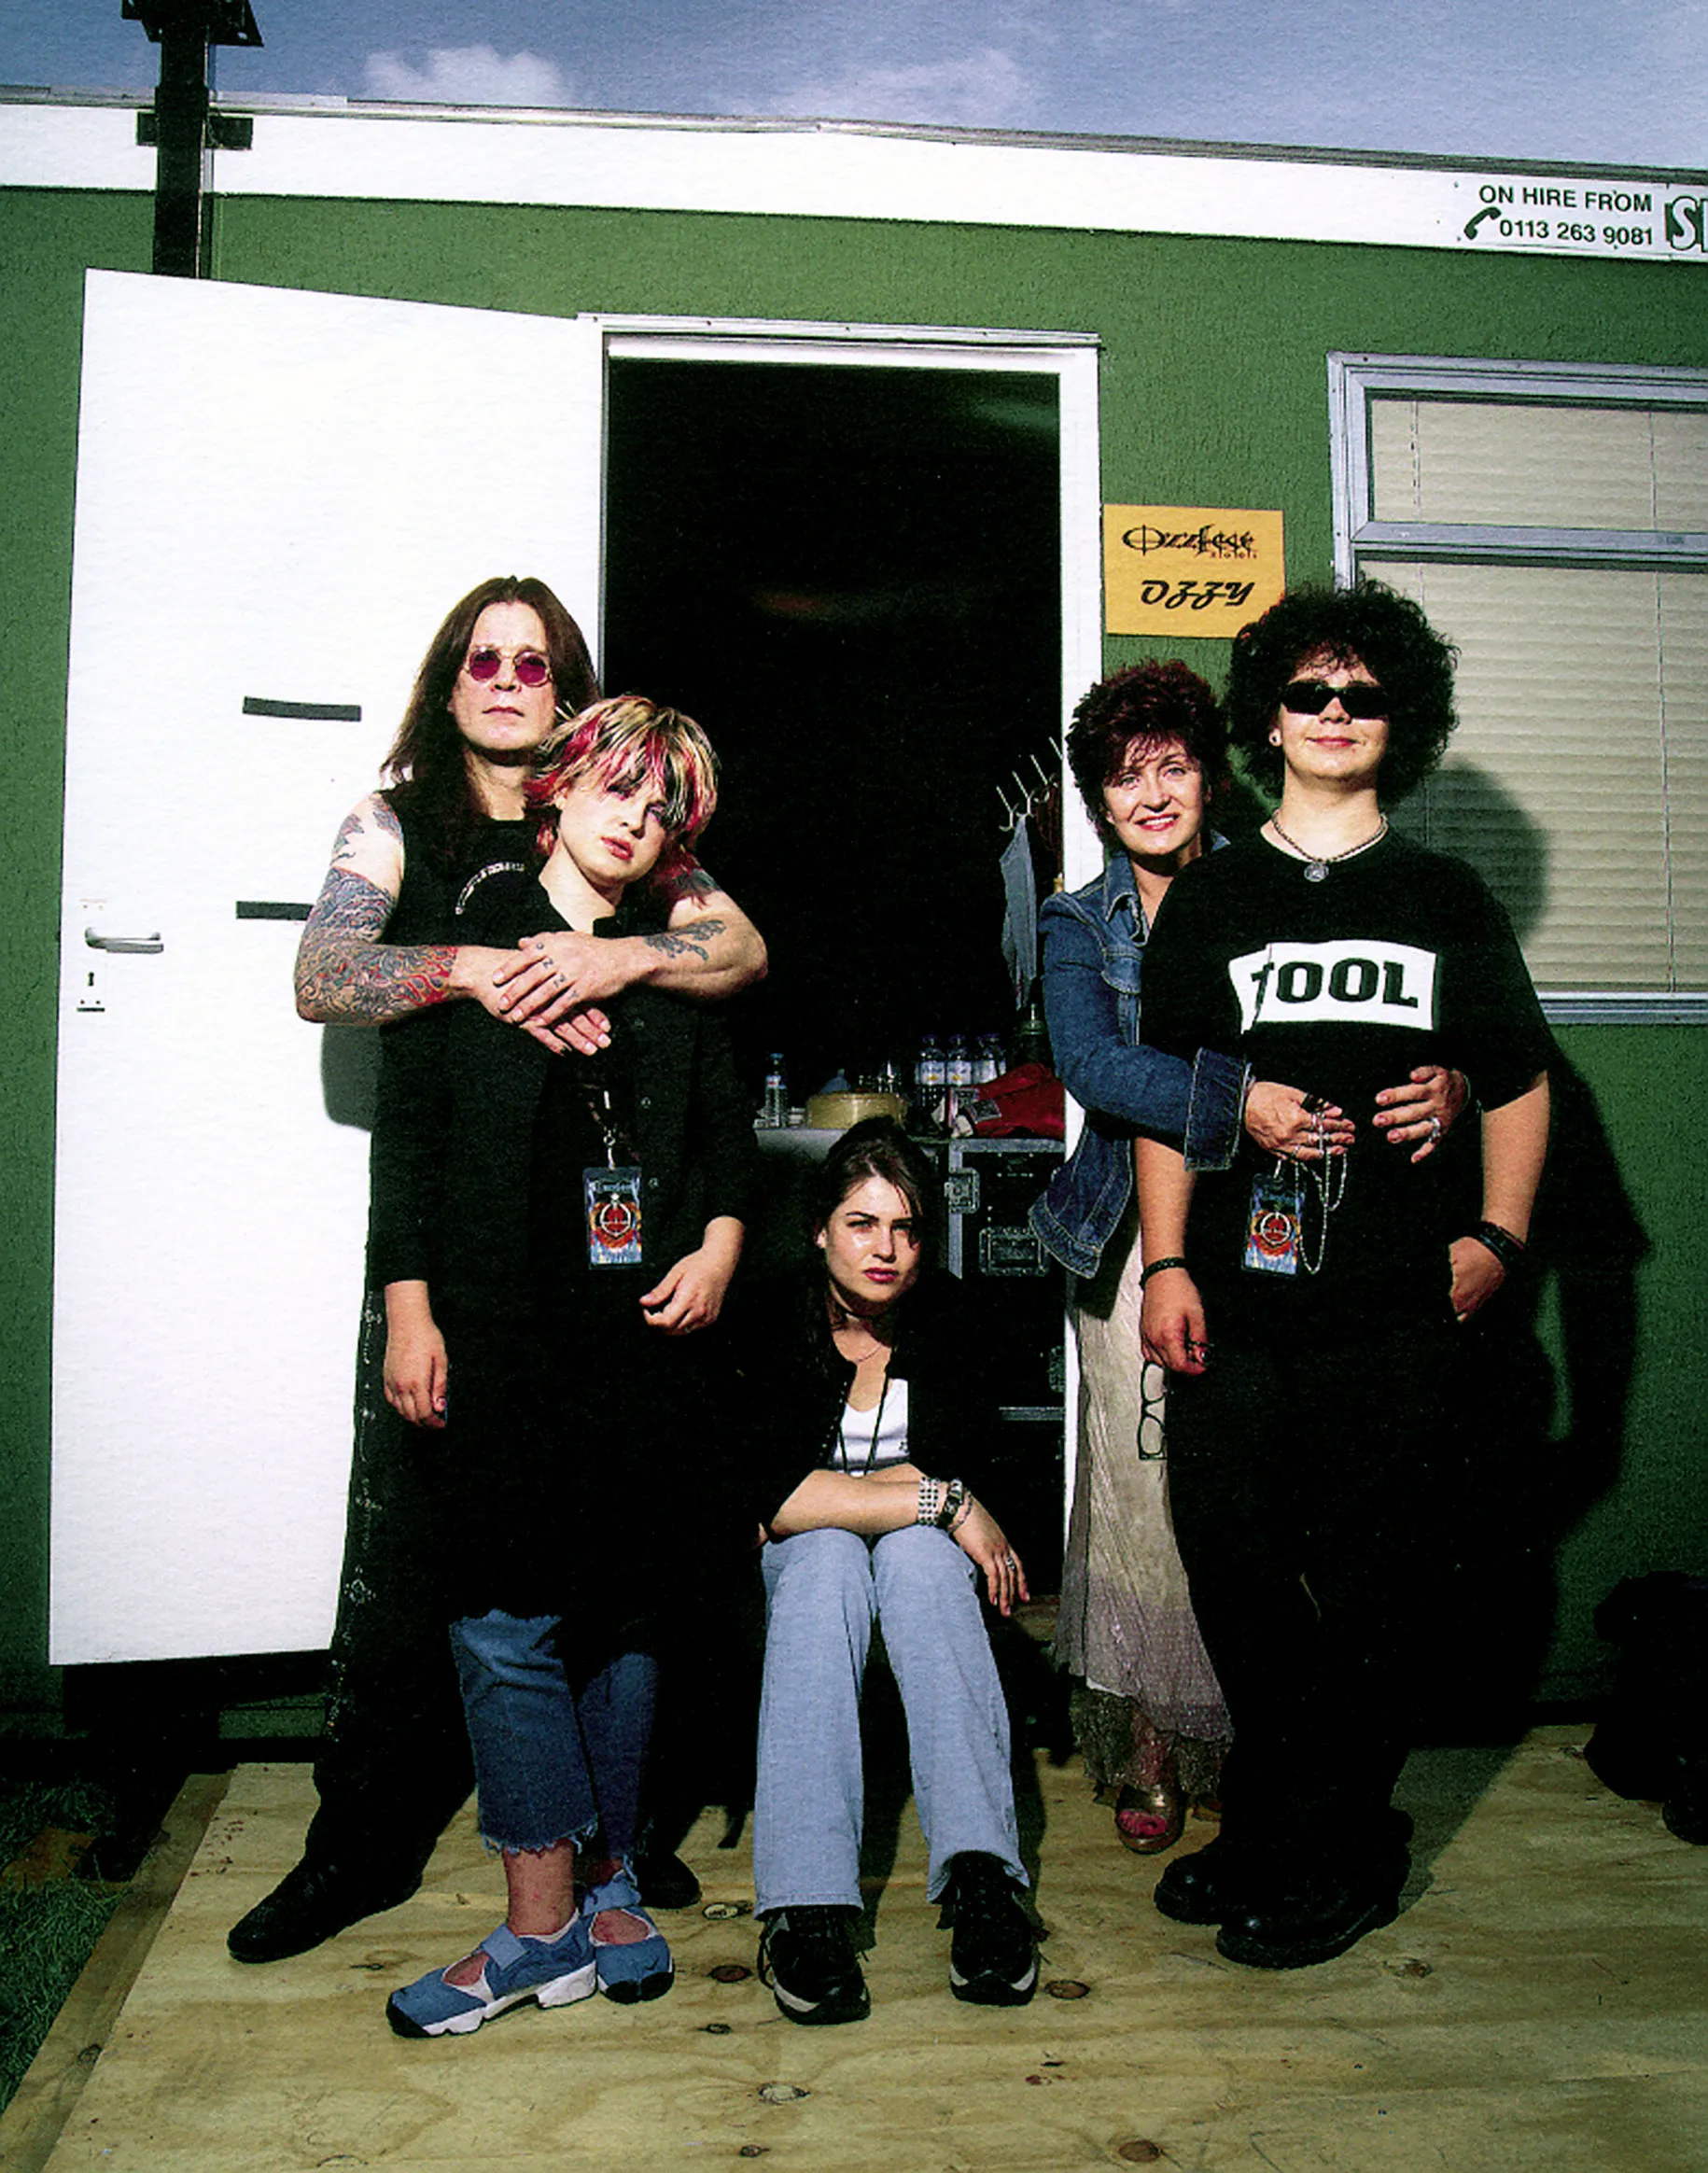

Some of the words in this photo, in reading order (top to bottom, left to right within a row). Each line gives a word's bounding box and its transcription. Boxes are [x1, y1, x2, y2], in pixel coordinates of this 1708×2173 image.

[1478, 185, 1514, 203] ON
[1522, 187, 1577, 207] HIRE
[1585, 191, 1652, 212] FROM
[1499, 220, 1549, 238] 0113
[1557, 222, 1596, 242] 263
[1603, 227, 1654, 245] 9081
